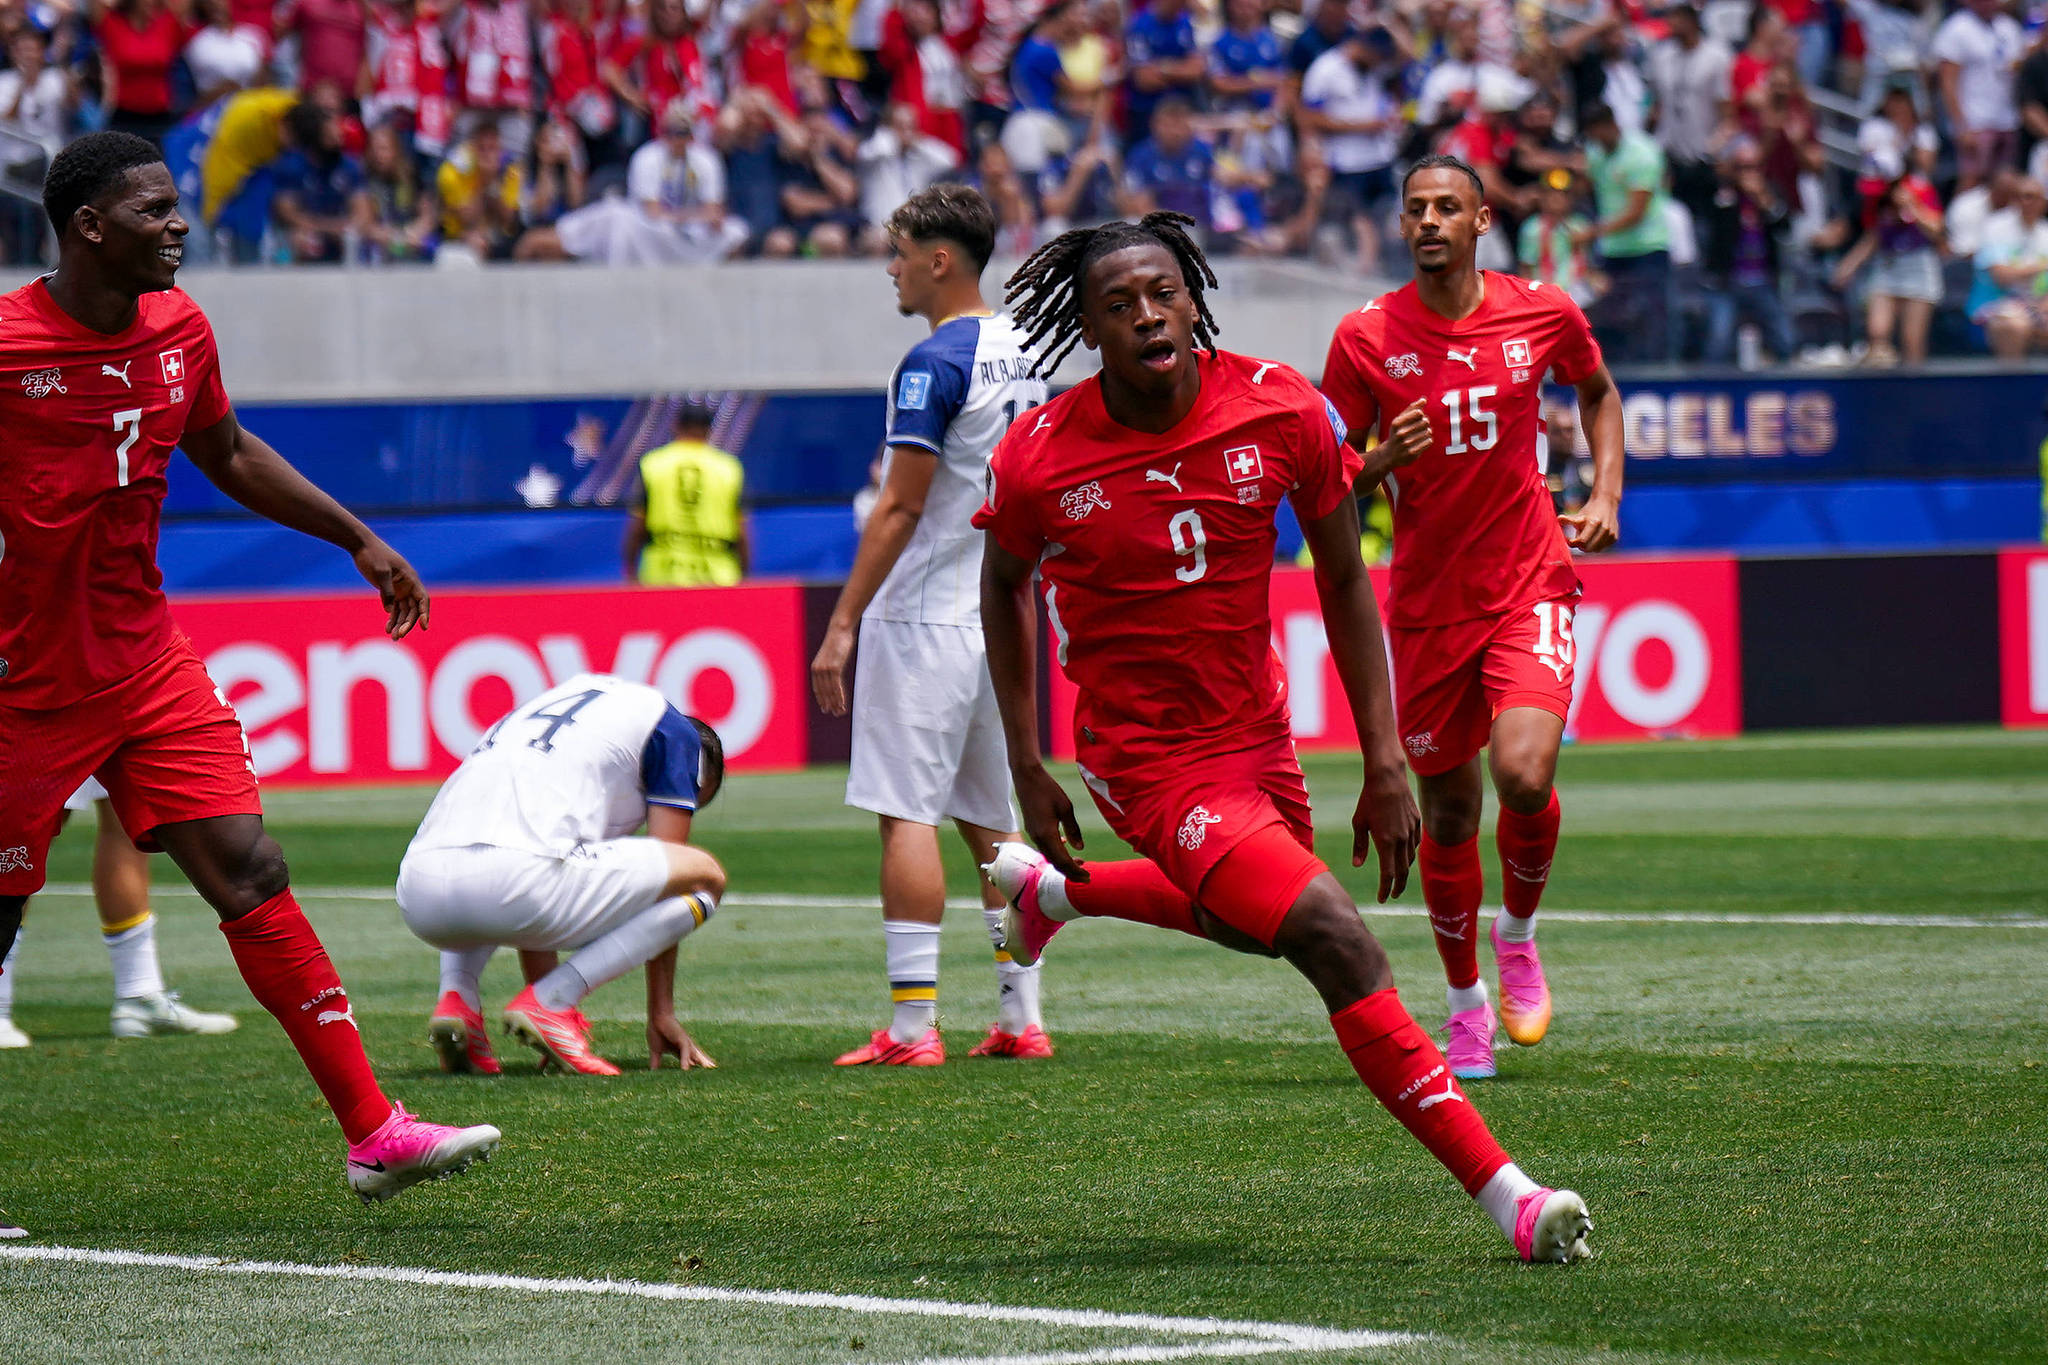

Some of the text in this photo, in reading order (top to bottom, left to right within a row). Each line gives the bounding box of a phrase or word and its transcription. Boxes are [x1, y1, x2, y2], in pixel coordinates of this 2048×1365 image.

[112, 407, 143, 487] 7
[1441, 385, 1499, 455] 15
[1574, 391, 1837, 460] GELES
[1168, 508, 1208, 583] 9
[204, 627, 775, 775] enoo
